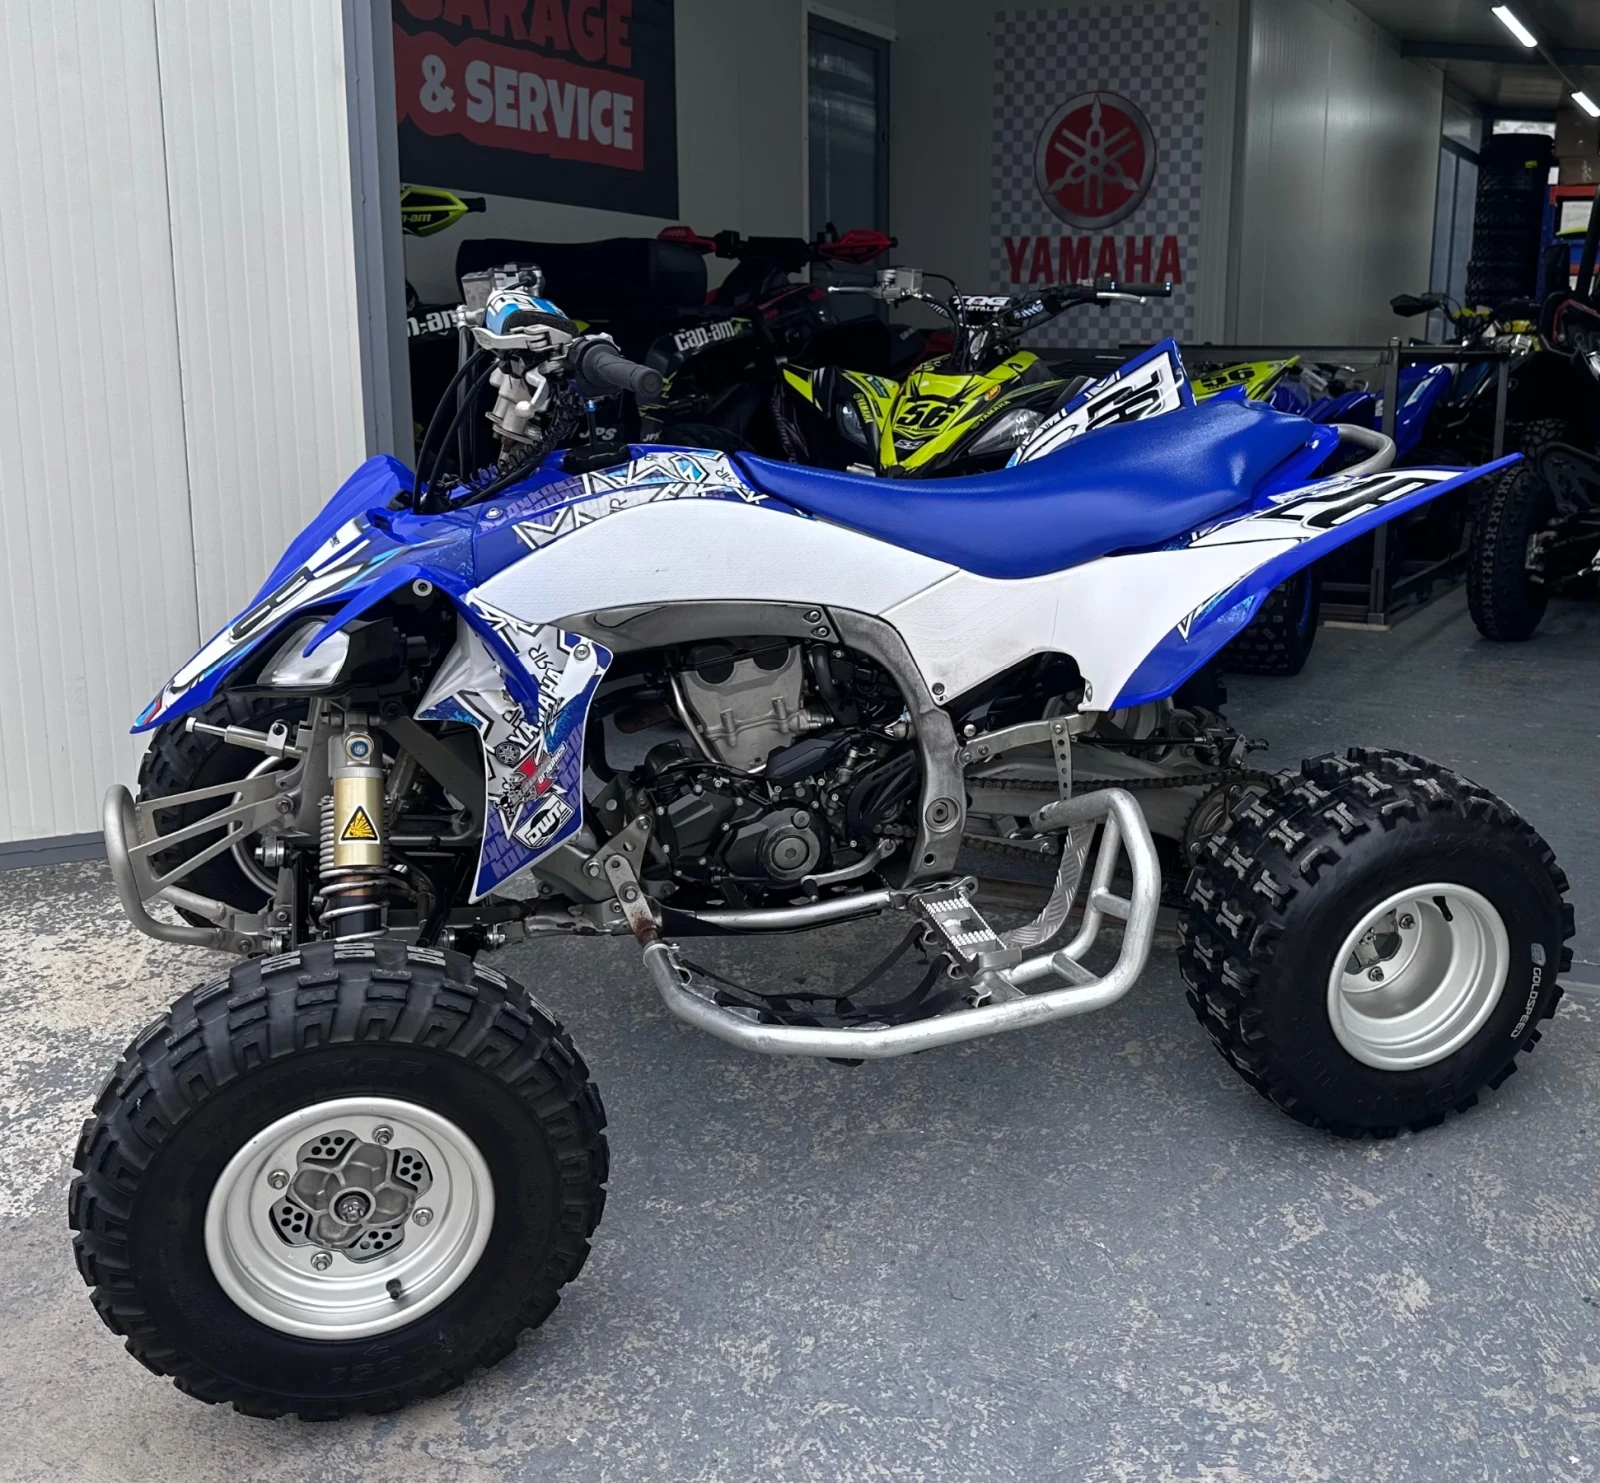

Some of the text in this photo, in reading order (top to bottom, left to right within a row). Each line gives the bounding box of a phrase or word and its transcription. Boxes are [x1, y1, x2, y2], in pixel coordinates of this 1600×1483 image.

[402, 0, 632, 68] AGE
[419, 54, 633, 150] & SERVICE
[1004, 235, 1182, 284] YAMAHA
[952, 295, 1010, 306] TAG
[673, 320, 736, 352] can-am
[1200, 367, 1255, 388] 56
[896, 401, 958, 428] 56
[979, 401, 1011, 423] YAMAHA
[526, 799, 567, 845] DWT
[1510, 967, 1542, 1038] GOLDSPEED
